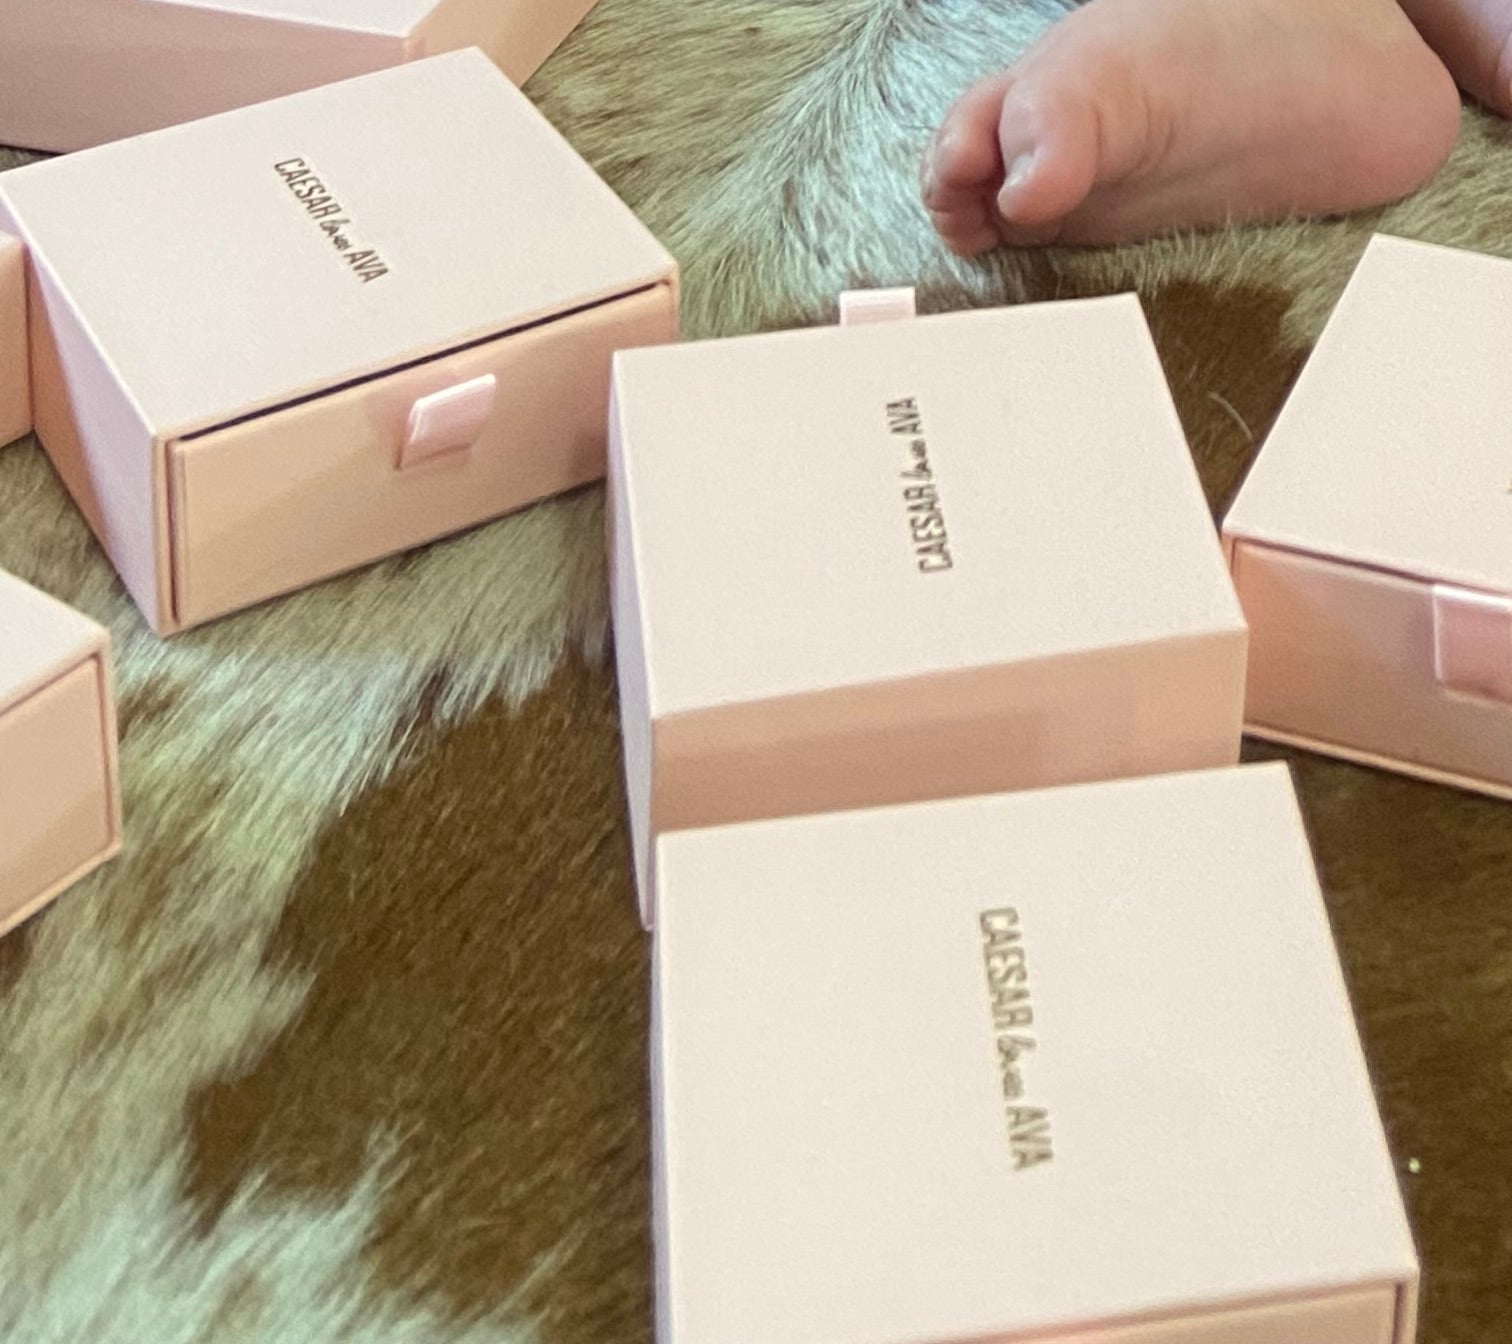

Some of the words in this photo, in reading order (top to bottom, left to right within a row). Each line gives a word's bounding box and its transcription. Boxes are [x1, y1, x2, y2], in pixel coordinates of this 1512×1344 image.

[273, 157, 342, 220] CAESAR
[342, 249, 389, 284] AVA
[886, 397, 923, 434] AVA
[903, 483, 953, 573] CAESAR
[979, 906, 1034, 1030] CAESAR
[1005, 1105, 1054, 1172] AVA
